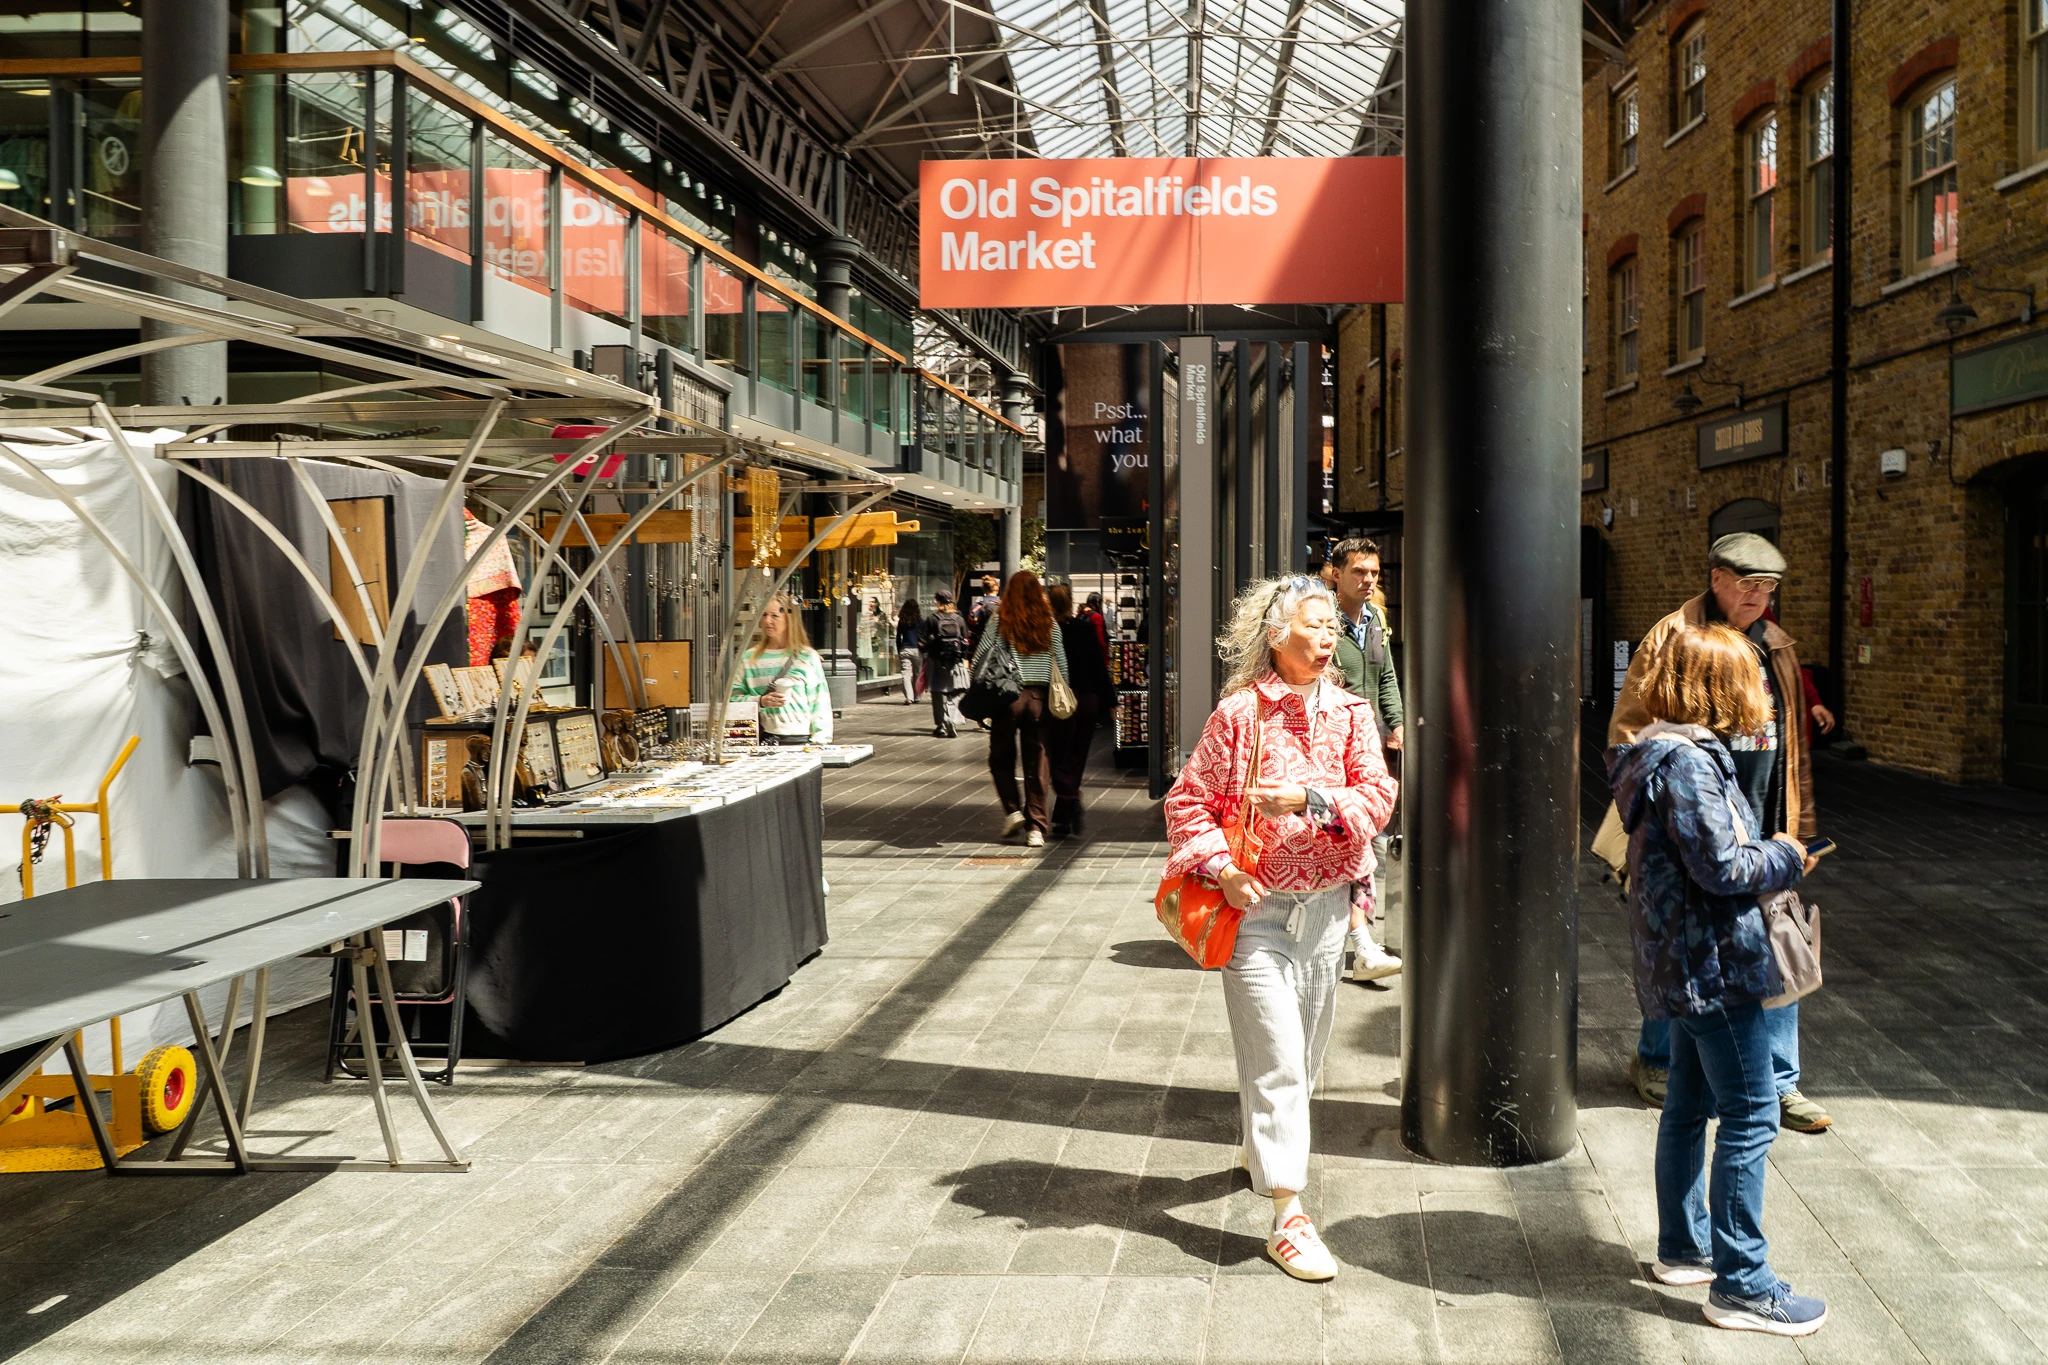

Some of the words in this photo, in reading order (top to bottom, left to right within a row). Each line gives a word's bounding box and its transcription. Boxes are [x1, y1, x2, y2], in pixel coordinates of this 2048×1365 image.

[939, 177, 1018, 220] Old
[1029, 175, 1278, 228] Spitalfields
[940, 230, 1097, 272] Market
[1185, 364, 1196, 401] Market
[1196, 364, 1207, 382] Old
[1094, 402, 1148, 419] Psst...
[1195, 385, 1207, 445] Spitalfields
[1094, 426, 1143, 443] what
[1111, 454, 1149, 473] you
